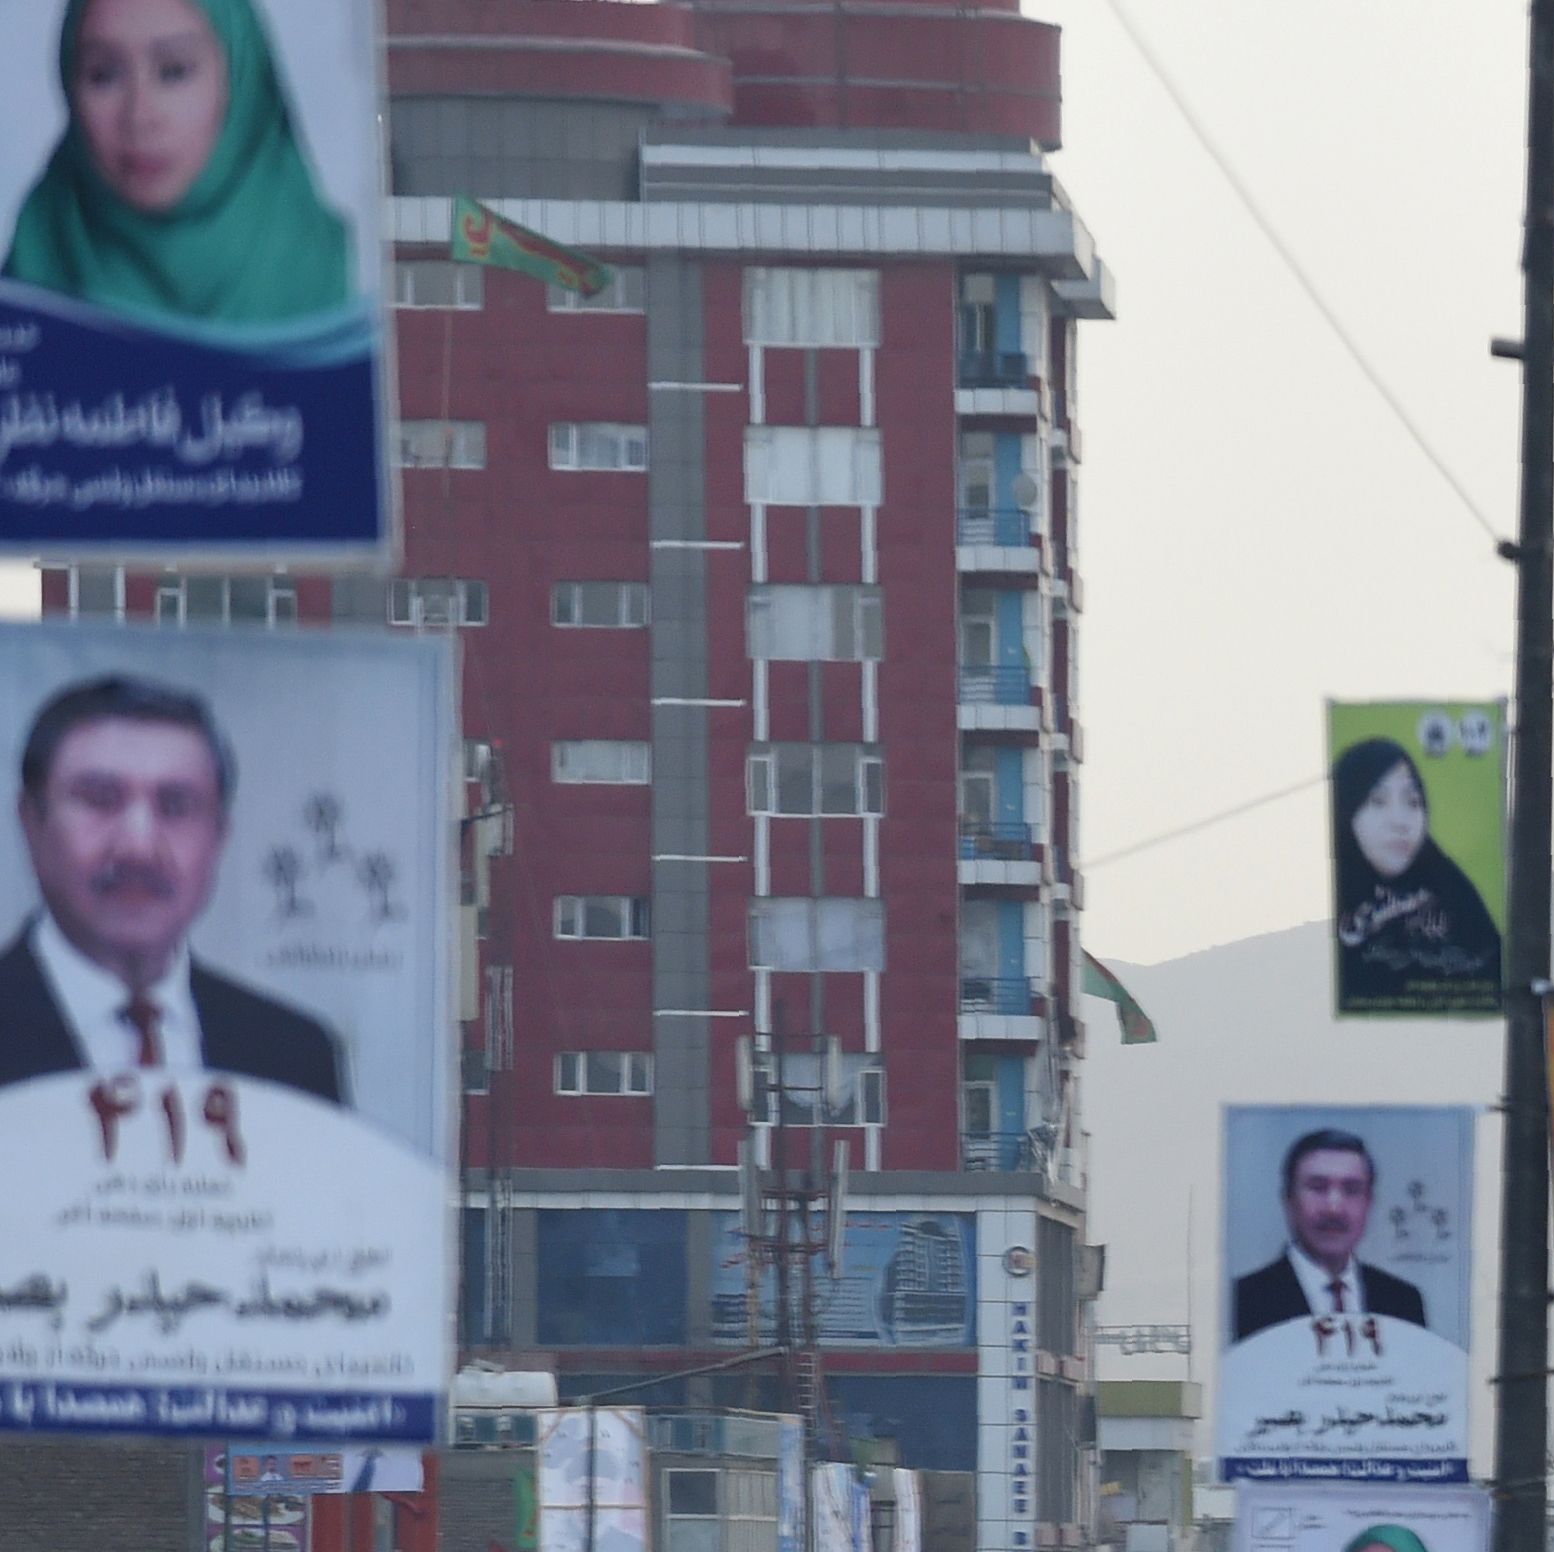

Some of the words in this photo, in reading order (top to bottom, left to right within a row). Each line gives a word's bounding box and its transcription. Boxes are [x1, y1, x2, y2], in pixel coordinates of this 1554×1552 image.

[1311, 1317, 1384, 1357] ۴۱۹
[1313, 1405, 1378, 1436] حیدر
[1378, 1405, 1447, 1428] محمد
